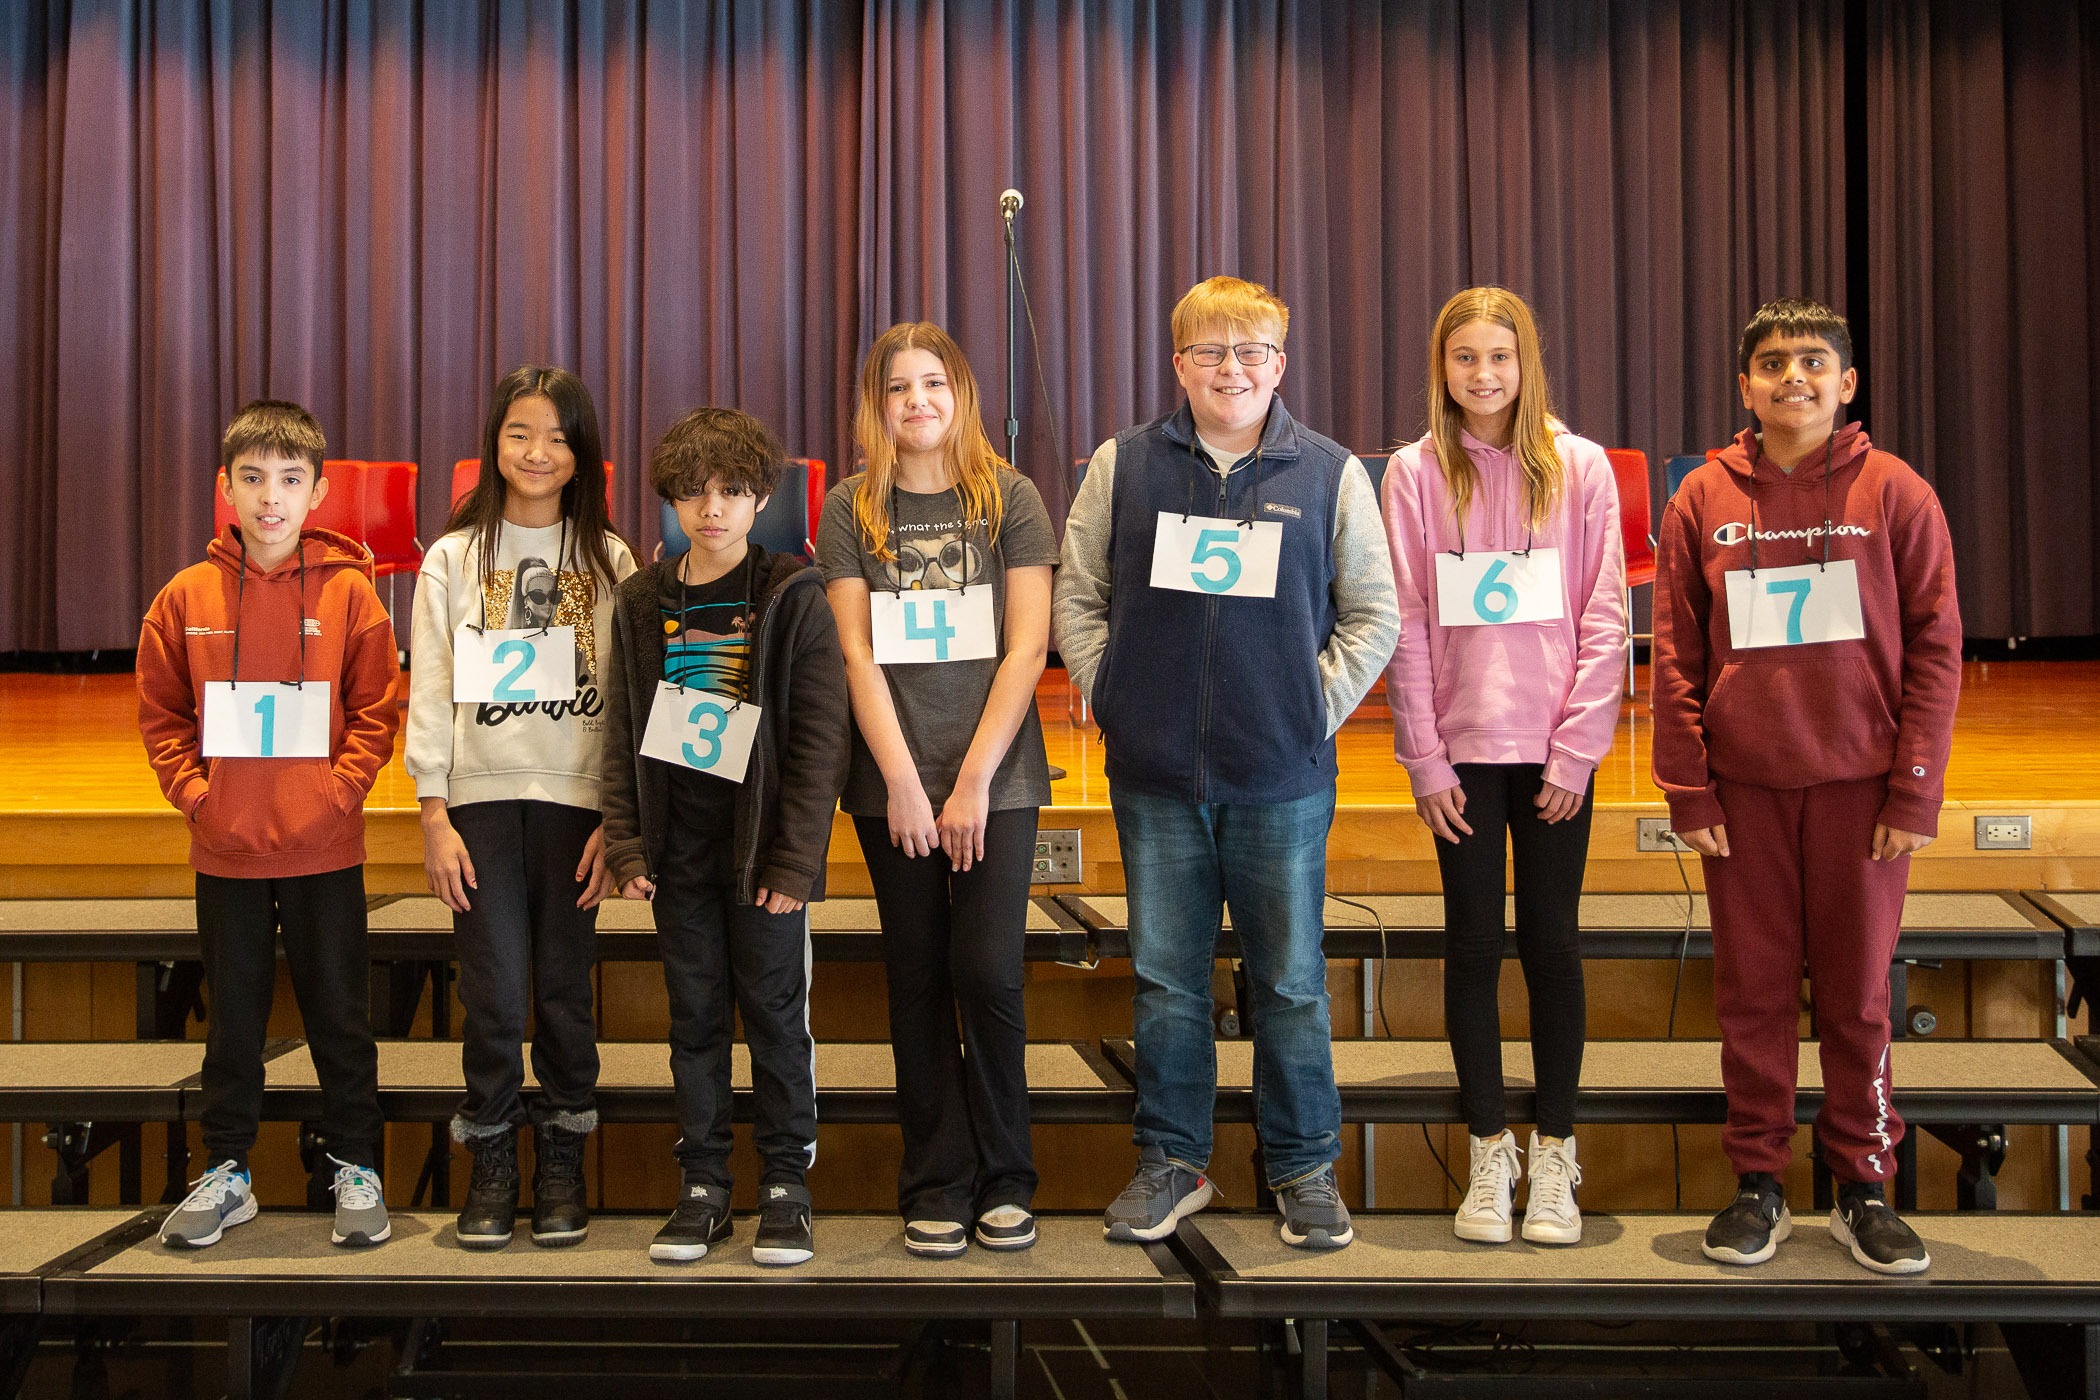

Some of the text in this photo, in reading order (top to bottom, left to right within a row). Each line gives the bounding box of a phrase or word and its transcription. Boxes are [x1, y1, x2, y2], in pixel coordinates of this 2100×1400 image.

[898, 522, 930, 532] what
[933, 521, 954, 531] the
[1272, 505, 1300, 516] Columbia
[1713, 519, 1871, 548] Champion
[1191, 529, 1242, 593] 5
[1473, 559, 1517, 623] 6
[905, 600, 955, 660] 4
[1767, 578, 1811, 644] 7
[493, 640, 536, 701] 2
[254, 694, 276, 757] 1
[682, 701, 728, 769] 3
